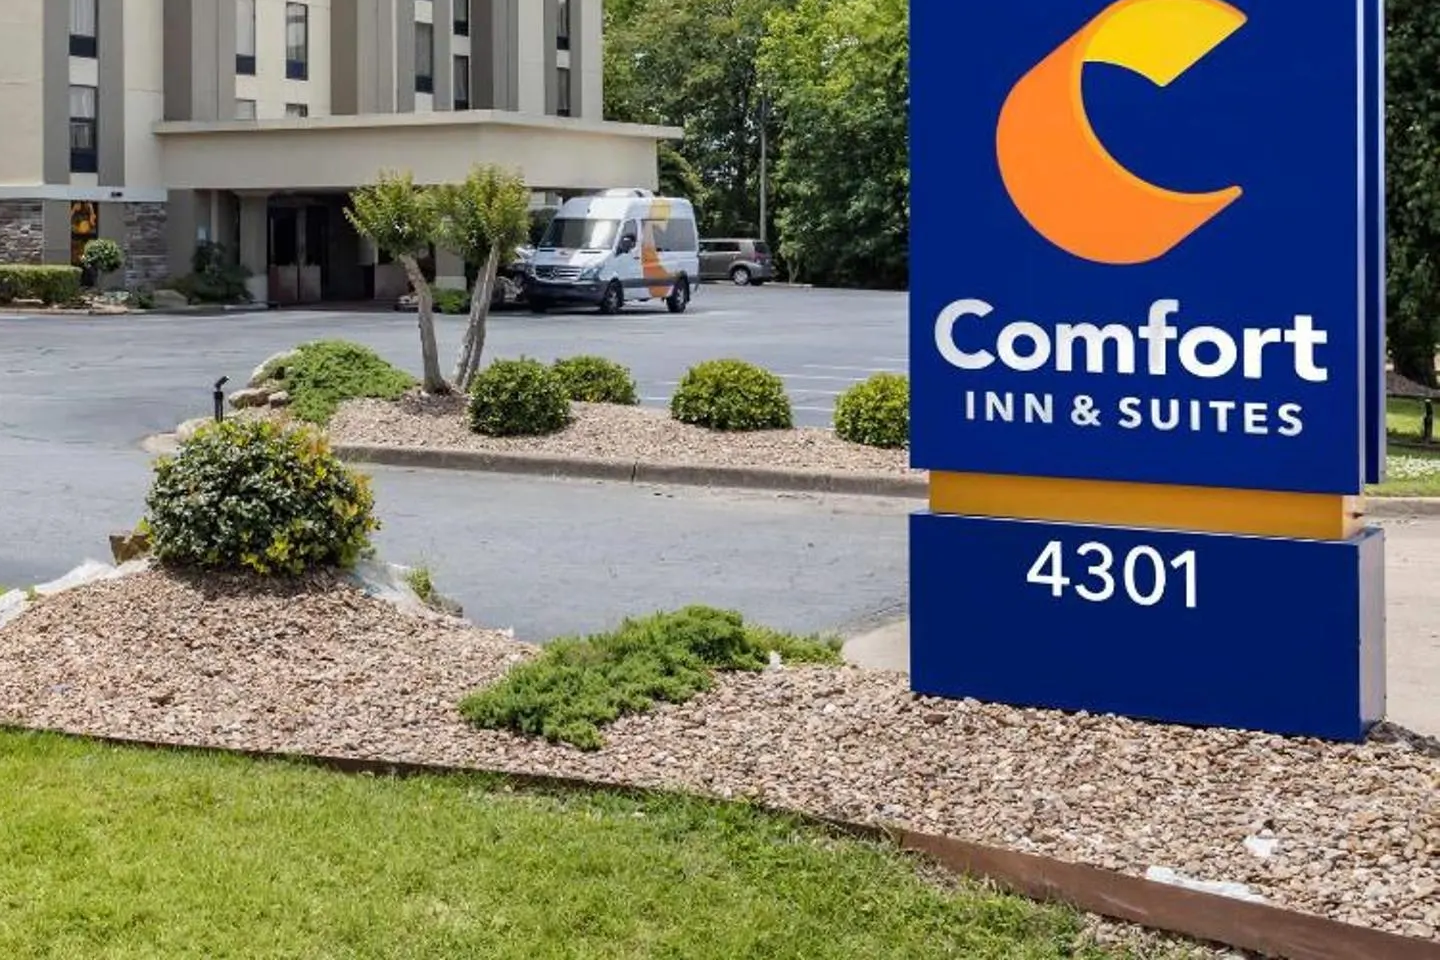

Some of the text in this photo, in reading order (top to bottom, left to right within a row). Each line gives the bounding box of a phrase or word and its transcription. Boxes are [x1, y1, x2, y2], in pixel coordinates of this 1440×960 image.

[934, 298, 1328, 382] Comfort
[965, 390, 1304, 437] INN & SUITES
[1025, 540, 1197, 608] 4301
